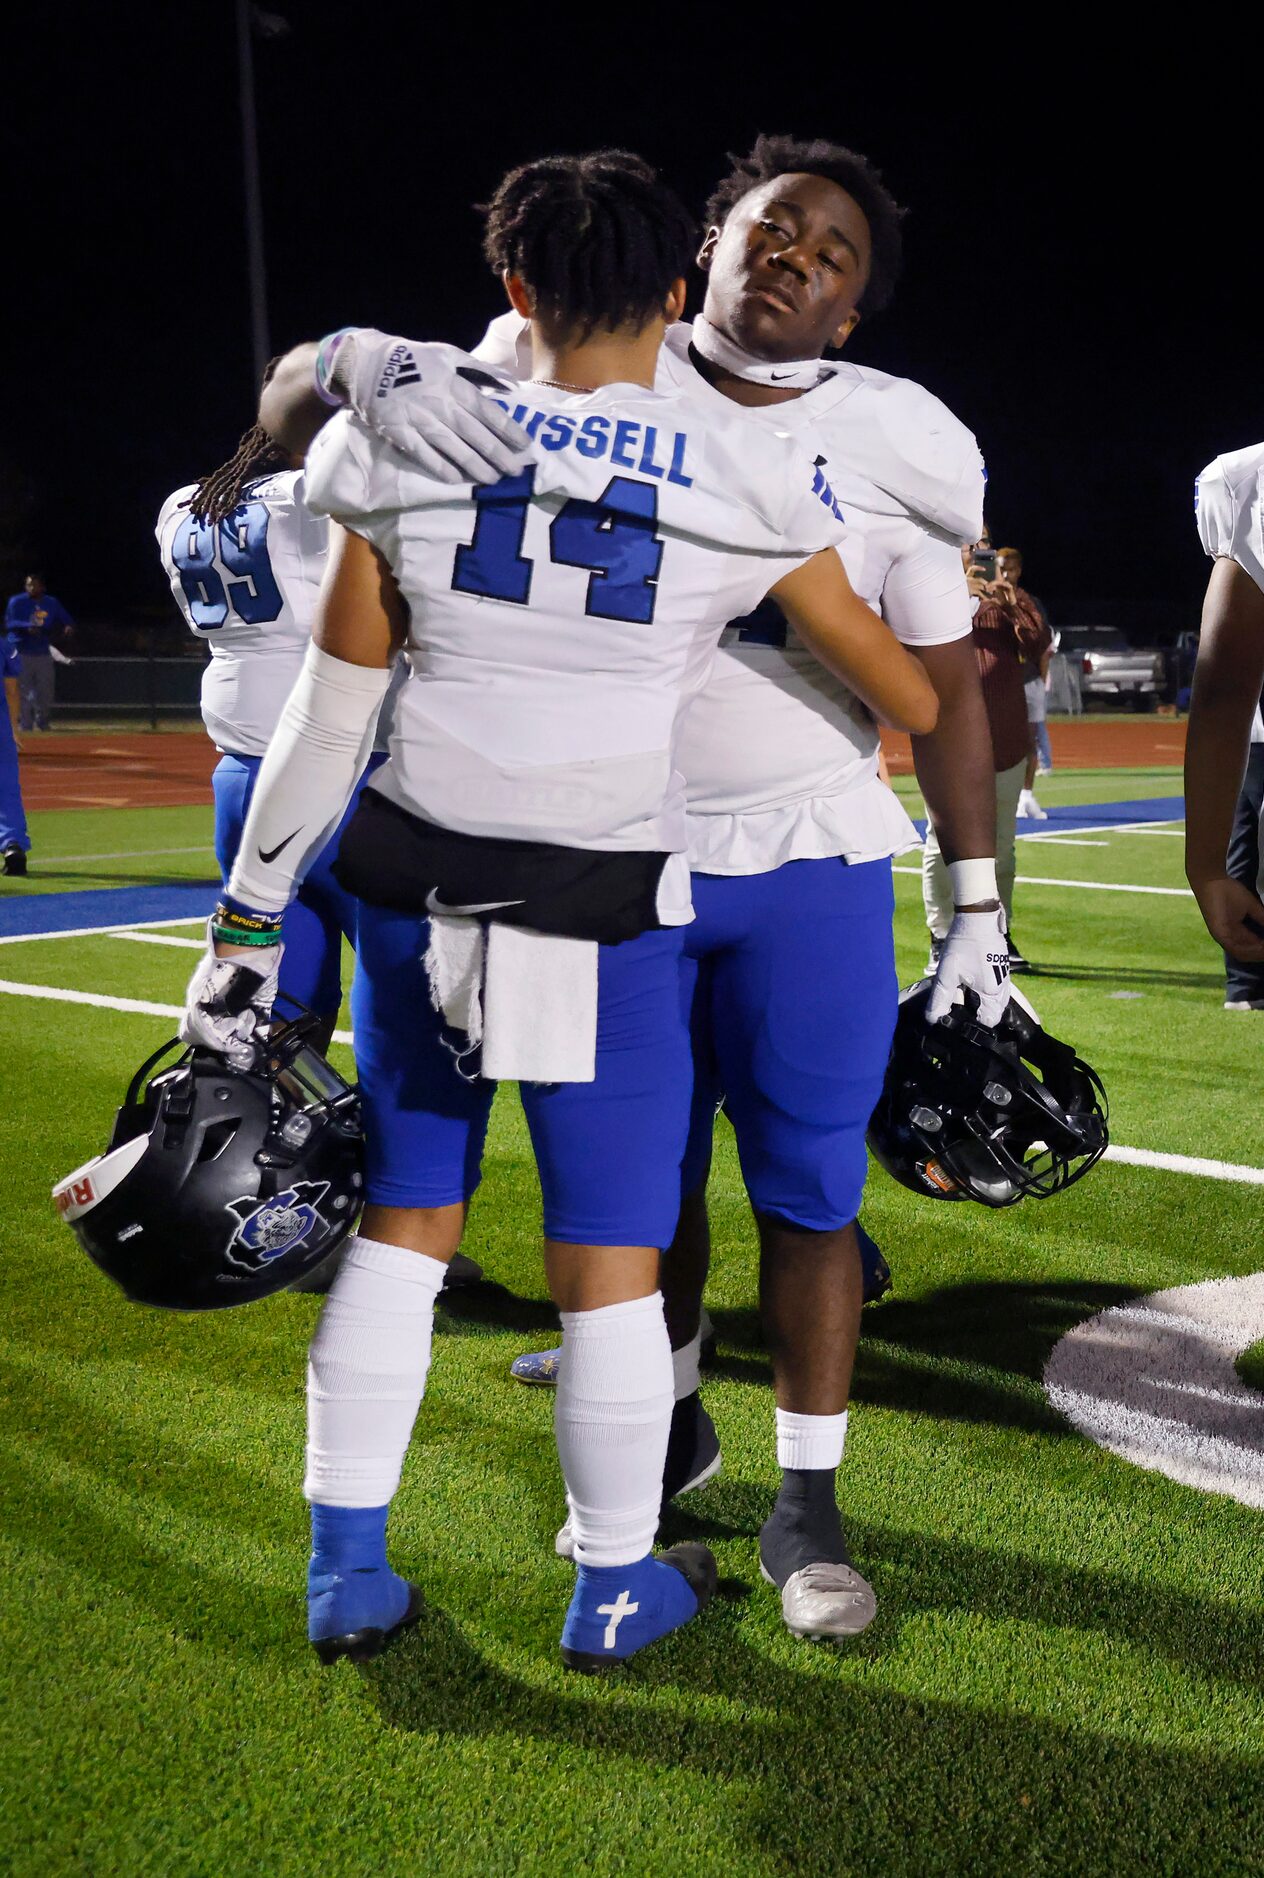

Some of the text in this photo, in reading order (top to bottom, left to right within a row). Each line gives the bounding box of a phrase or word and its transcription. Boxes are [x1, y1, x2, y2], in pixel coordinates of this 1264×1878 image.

[490, 398, 694, 489] USSELL
[171, 501, 285, 631] 89
[450, 463, 666, 625] 14
